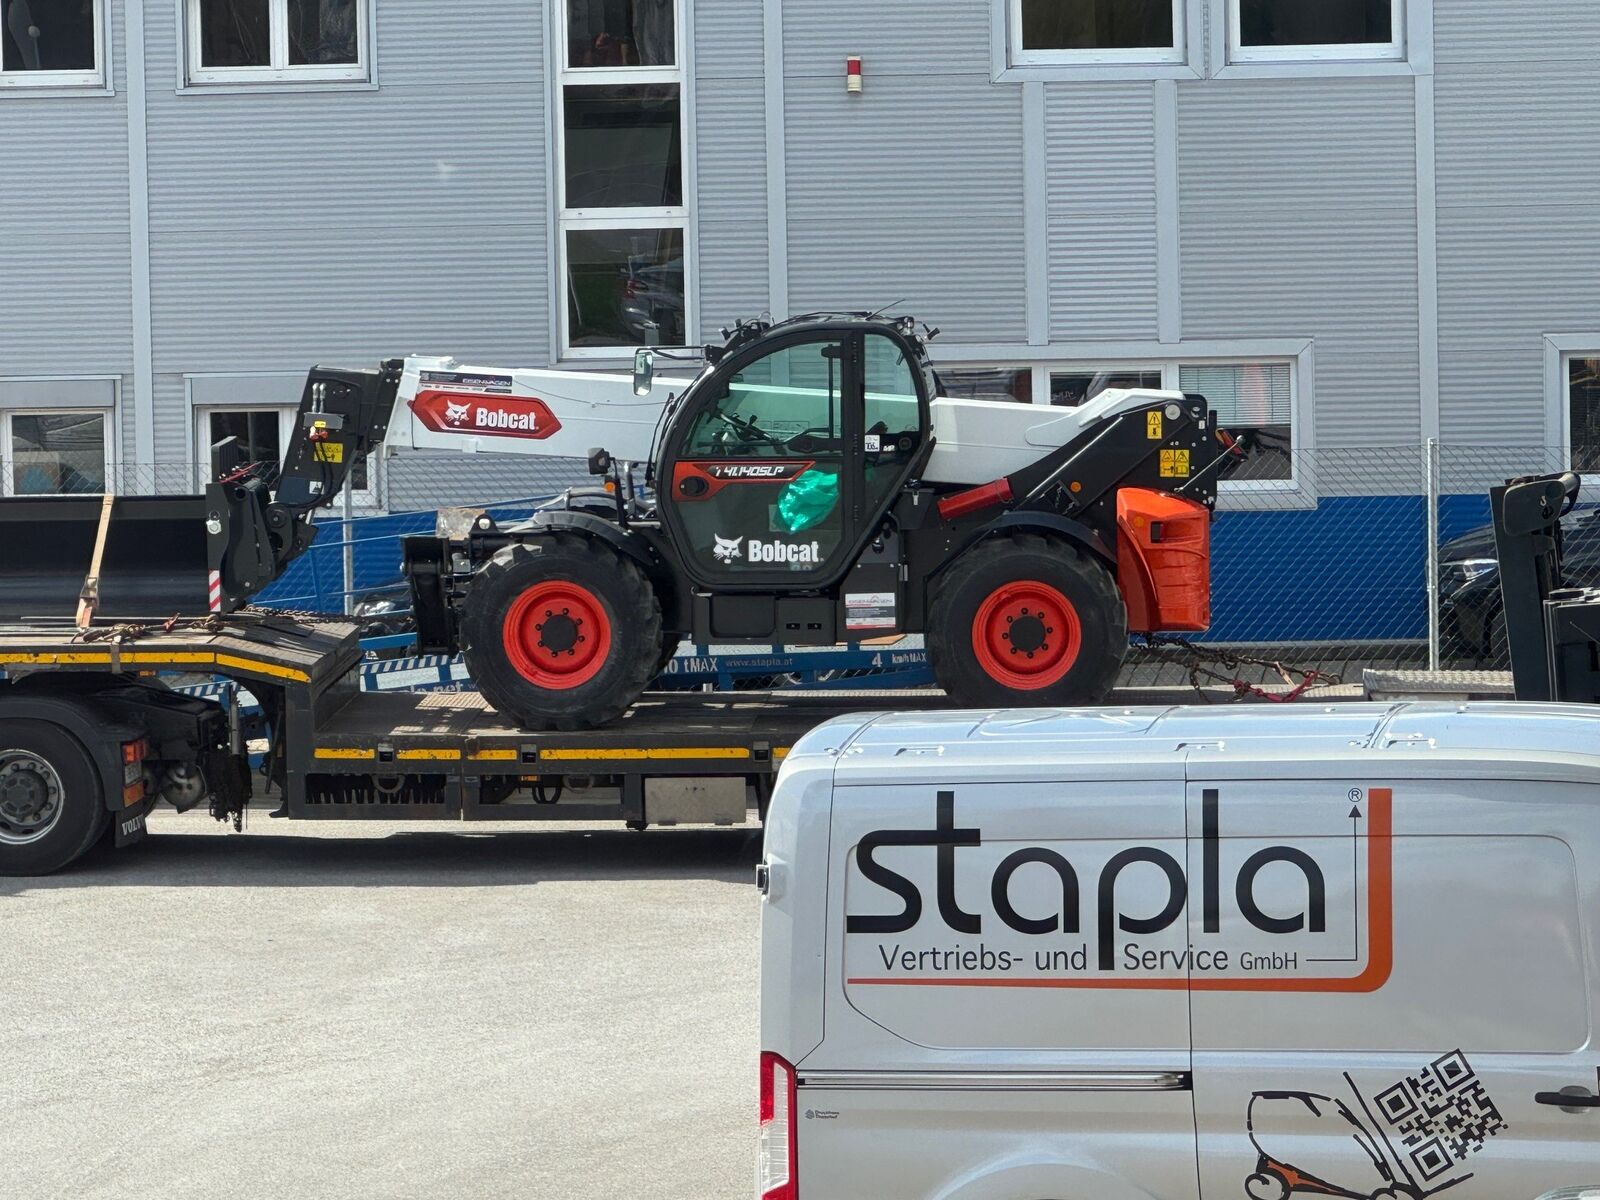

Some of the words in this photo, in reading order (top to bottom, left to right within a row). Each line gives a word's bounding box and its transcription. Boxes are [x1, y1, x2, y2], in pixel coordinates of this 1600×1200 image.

[476, 407, 536, 430] Bobcat
[748, 540, 819, 562] Bobcat
[872, 652, 883, 668] 4
[847, 789, 1326, 970] stapla
[879, 944, 1023, 971] Vertriebs-
[1034, 944, 1088, 971] und
[1124, 942, 1229, 971] Service
[1240, 951, 1298, 971] GmbH
